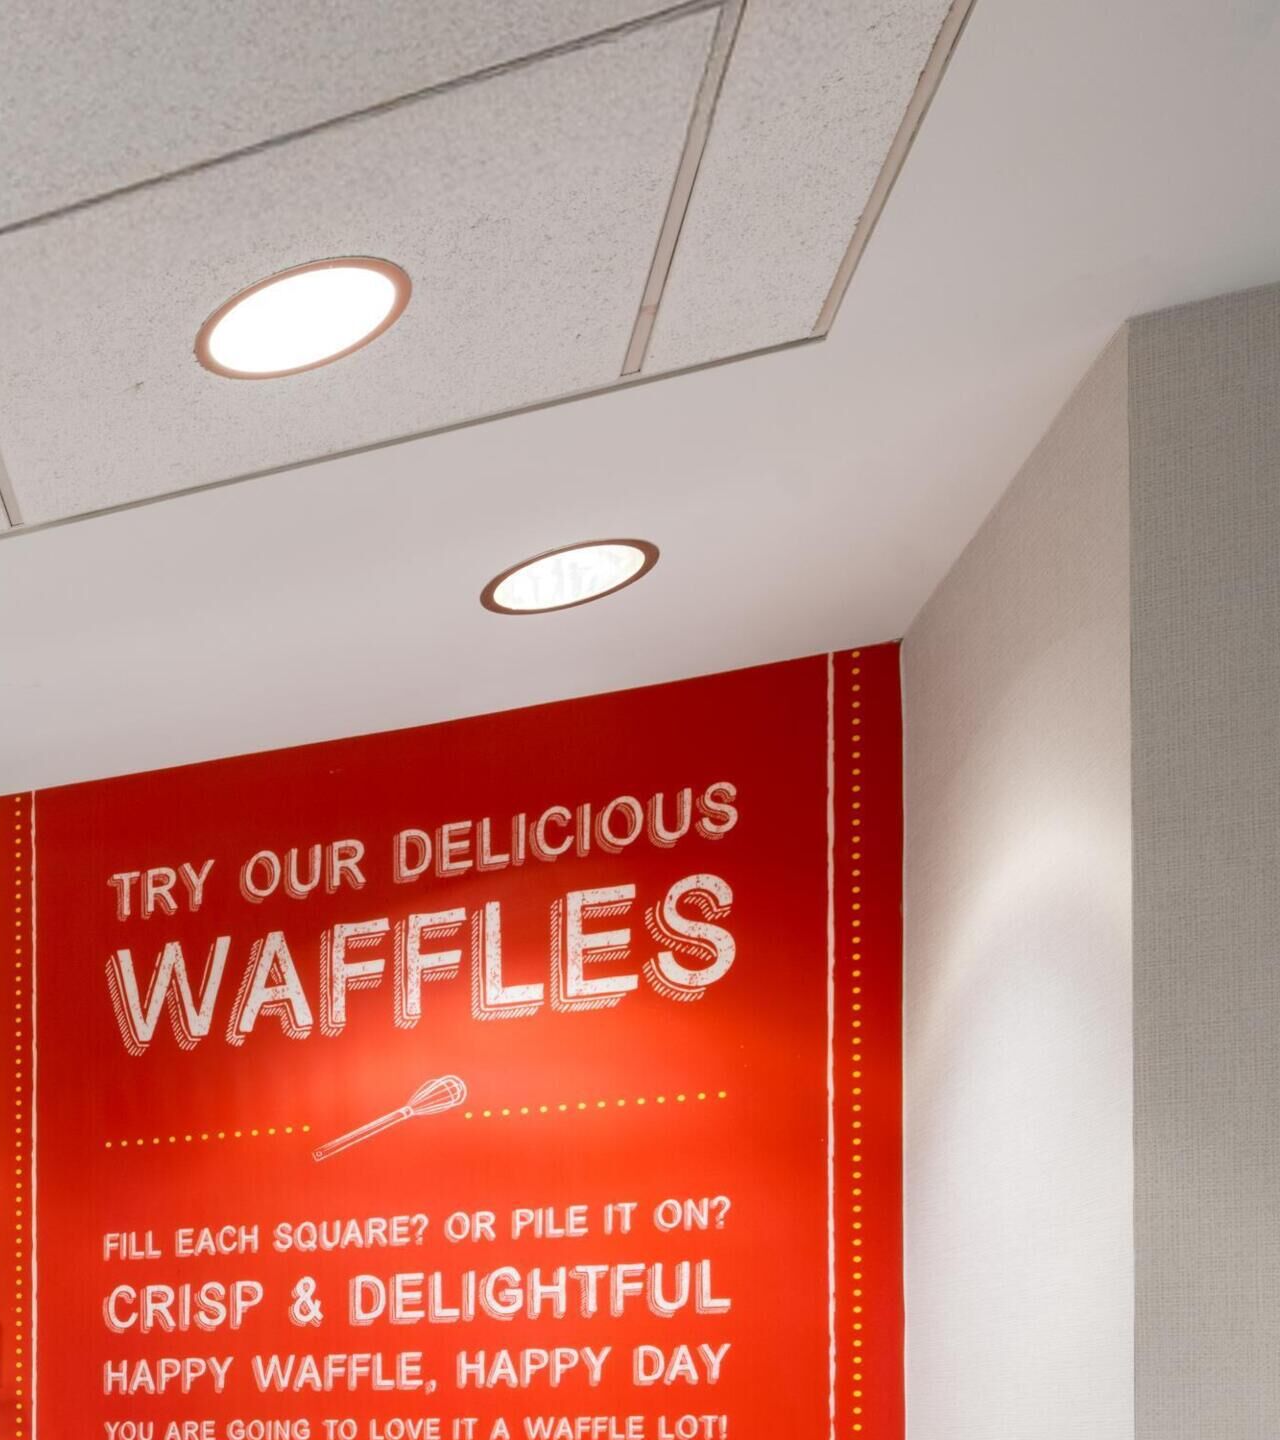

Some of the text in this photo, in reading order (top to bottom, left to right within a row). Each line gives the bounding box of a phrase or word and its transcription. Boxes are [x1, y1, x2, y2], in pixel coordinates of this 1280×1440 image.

[107, 781, 738, 922] TRY OUR DELICIOUS
[105, 873, 736, 1056] WAFFLES
[103, 1195, 730, 1261] FILL EACH SQUARE? OR PILE IT ON?
[102, 1259, 731, 1334] CRISP & DELIGHTFUL
[103, 1343, 731, 1395] HAPPY WAFFLE, HAPPY DAY
[658, 1414, 728, 1440] LOT!
